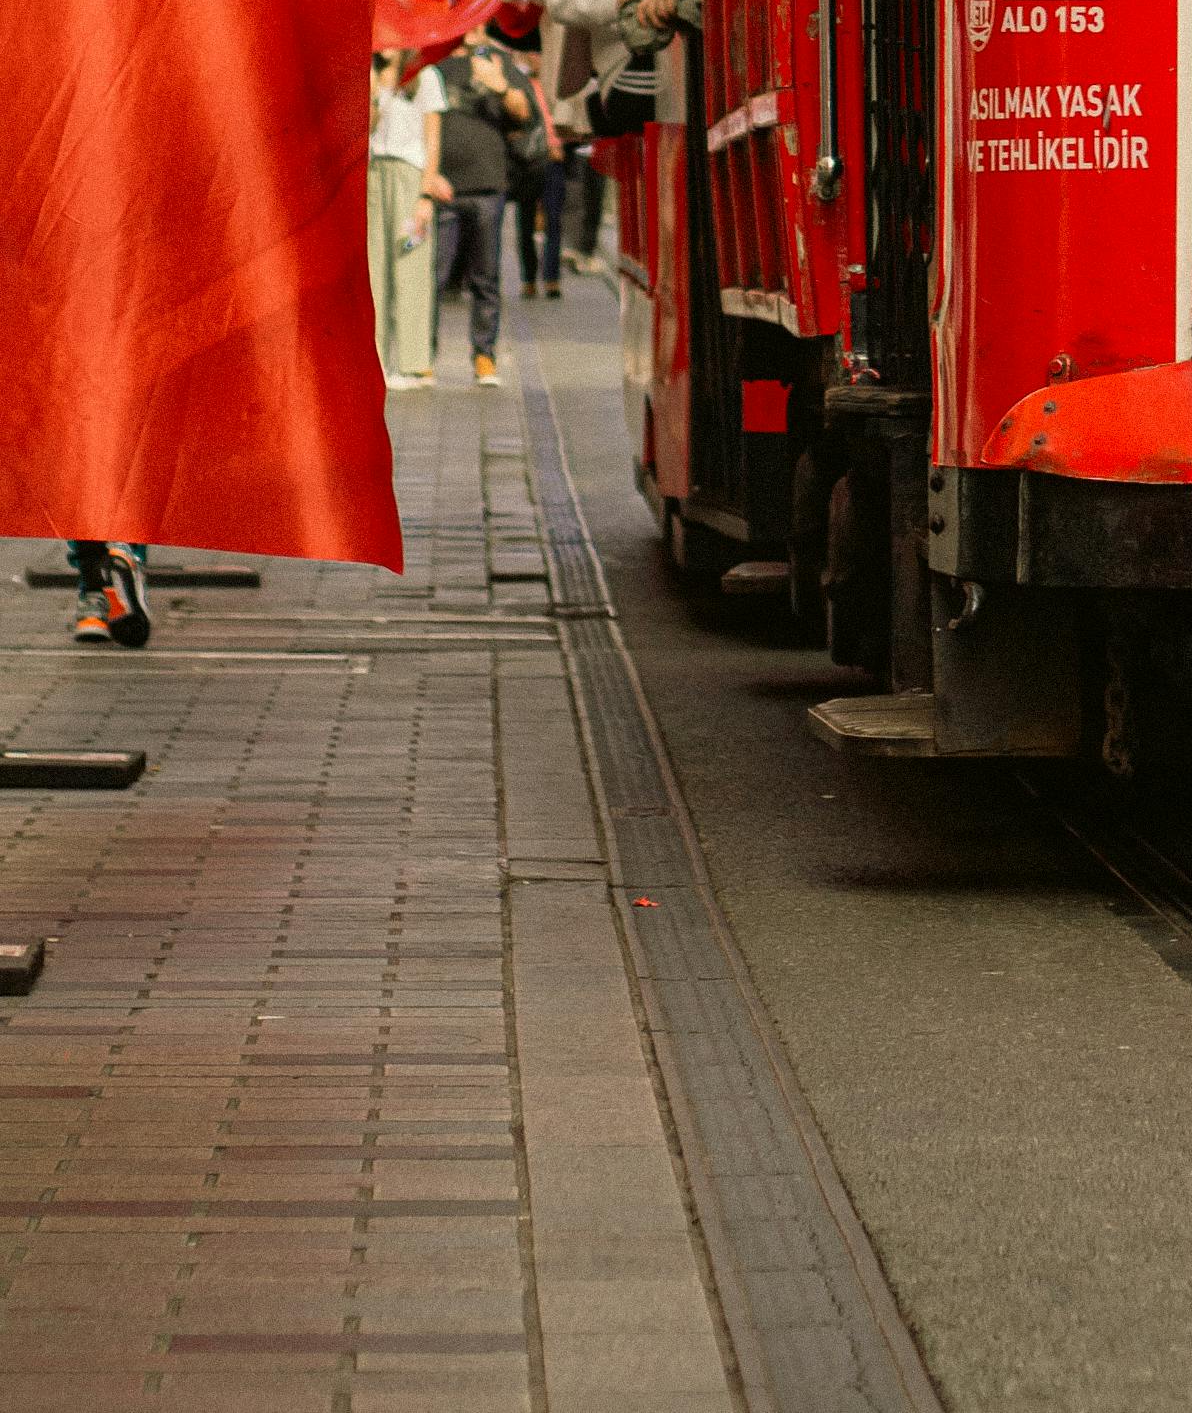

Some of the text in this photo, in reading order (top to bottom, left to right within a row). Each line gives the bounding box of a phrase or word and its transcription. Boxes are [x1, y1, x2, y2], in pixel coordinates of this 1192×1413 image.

[1001, 6, 1105, 33] ALO 153
[969, 83, 1142, 120] ASILMAK YASAK
[966, 129, 1149, 172] VE TEHLİKELİDİR
